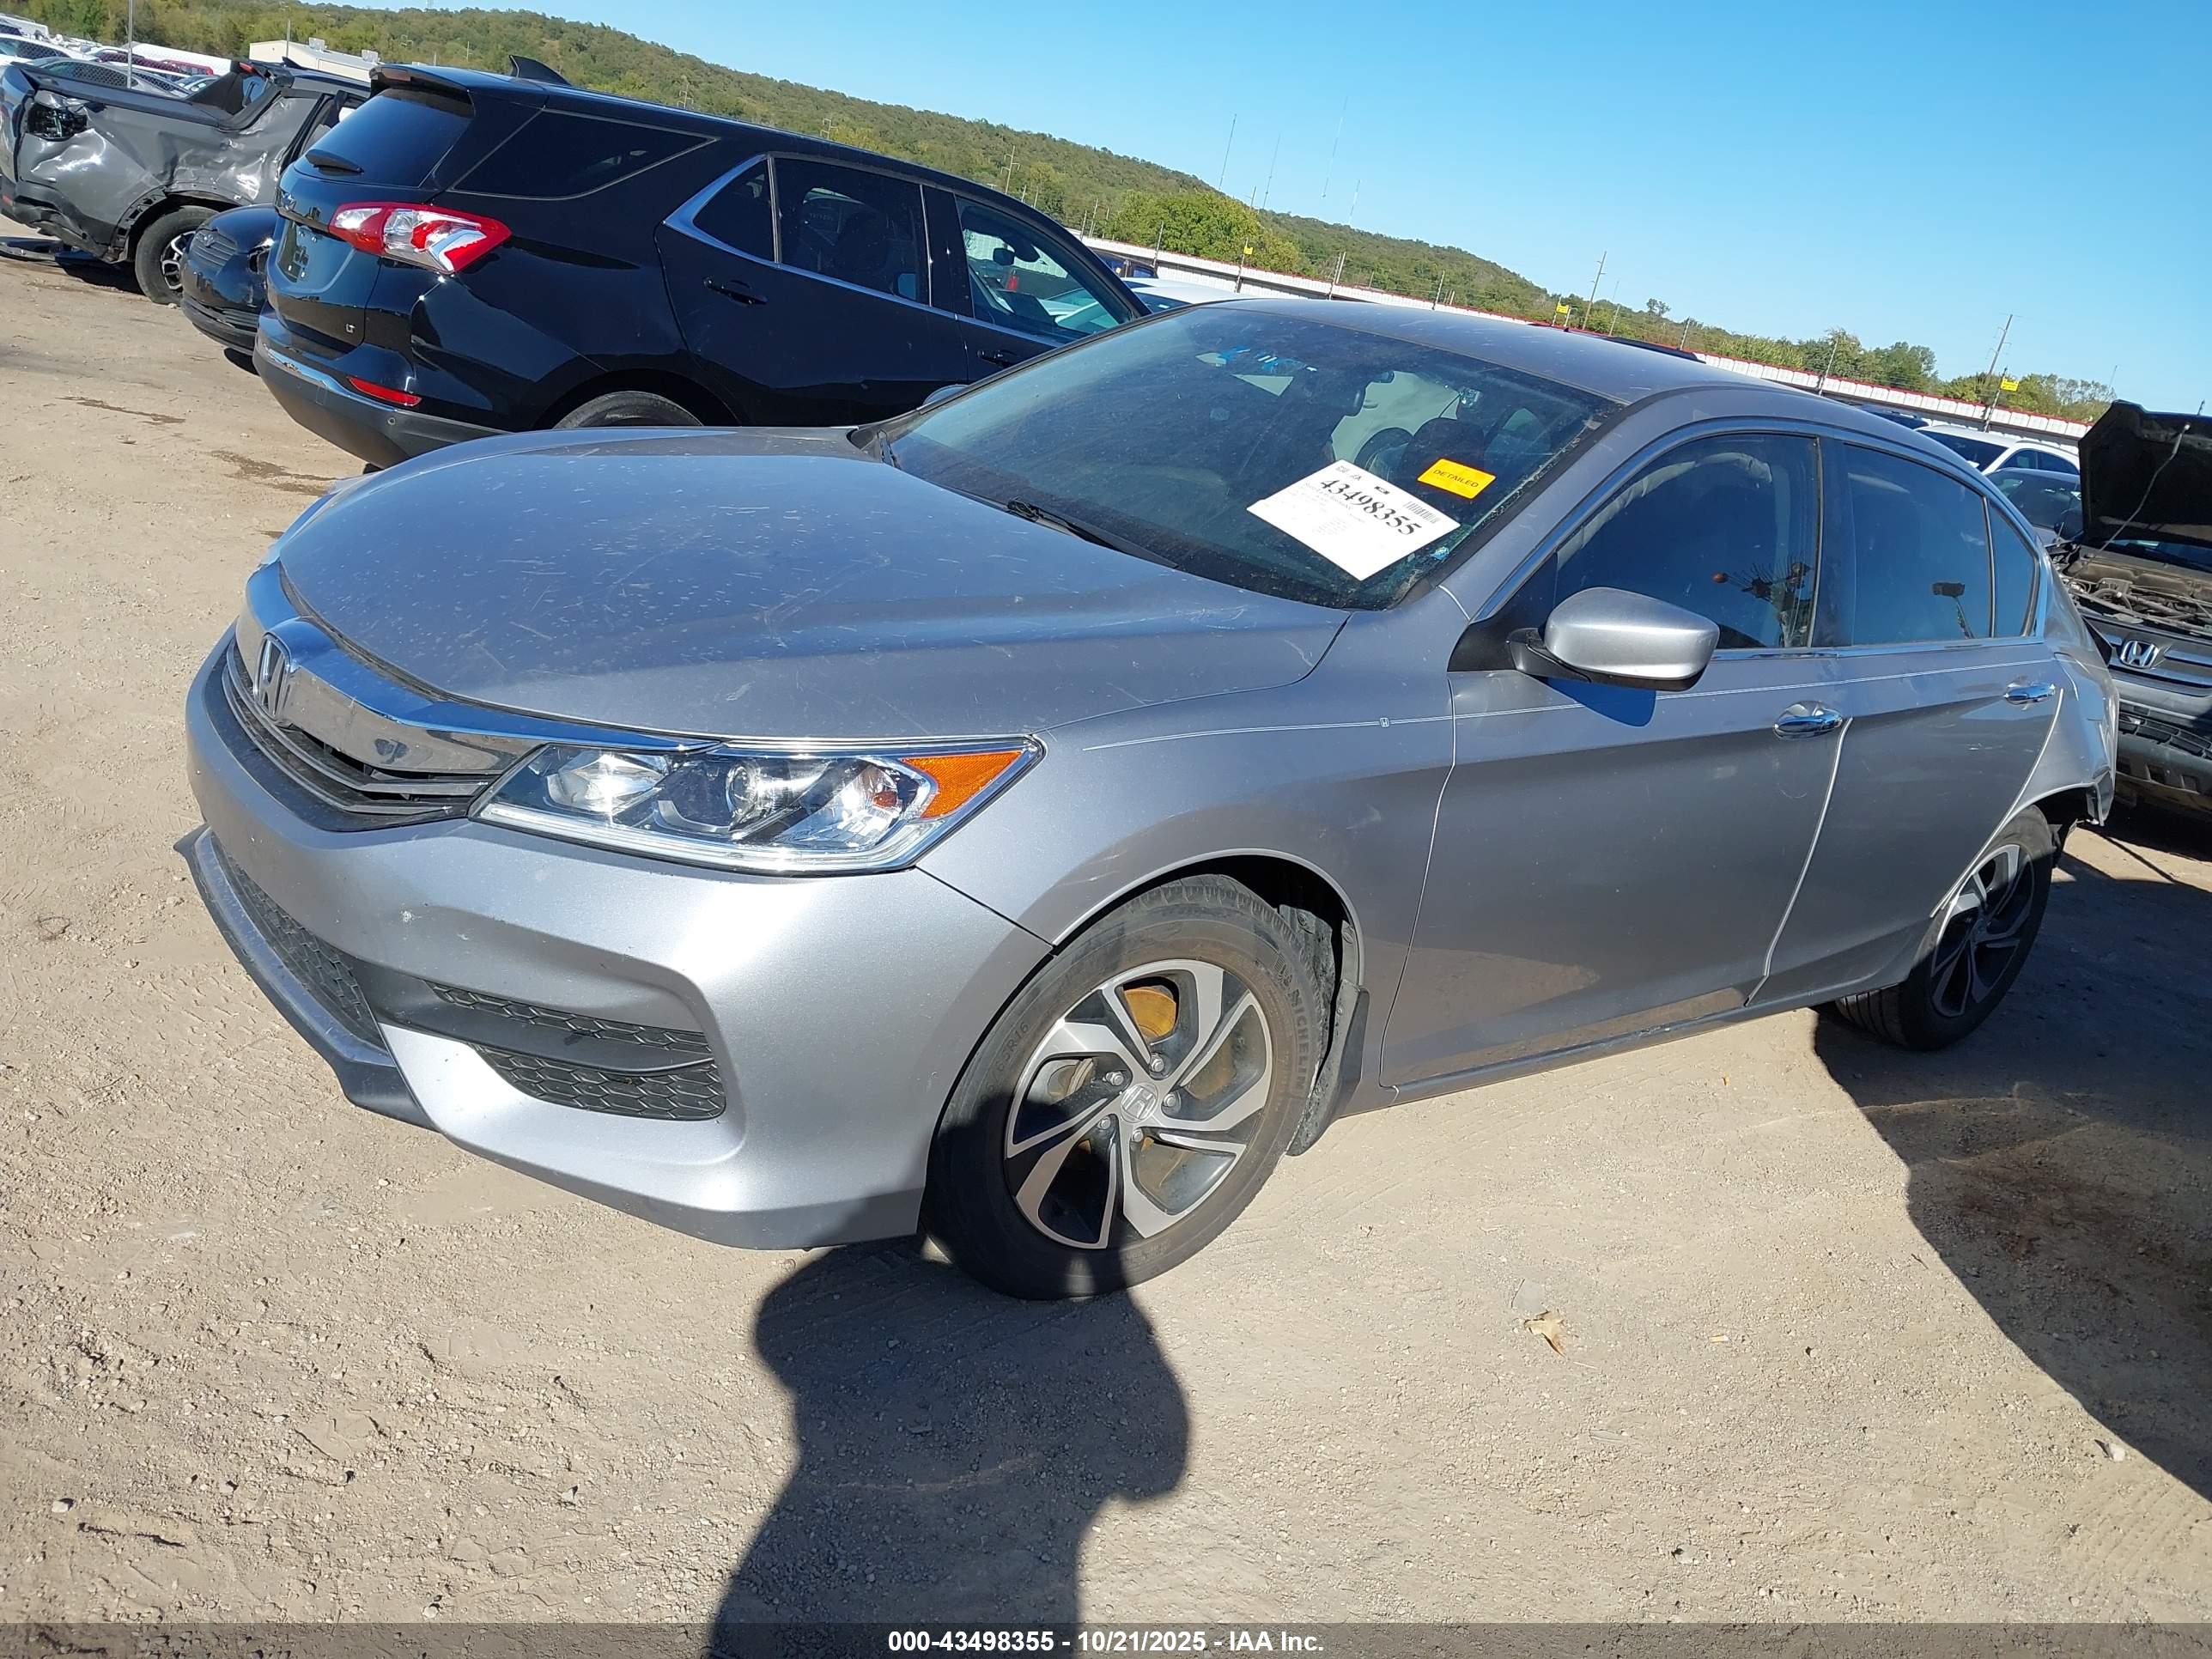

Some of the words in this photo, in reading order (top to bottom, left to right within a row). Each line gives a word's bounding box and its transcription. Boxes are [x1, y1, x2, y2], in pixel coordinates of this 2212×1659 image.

[1432, 469, 1480, 488] DETAILED
[1321, 479, 1422, 535] 43498355
[1287, 988, 1310, 1090] MICHELIN
